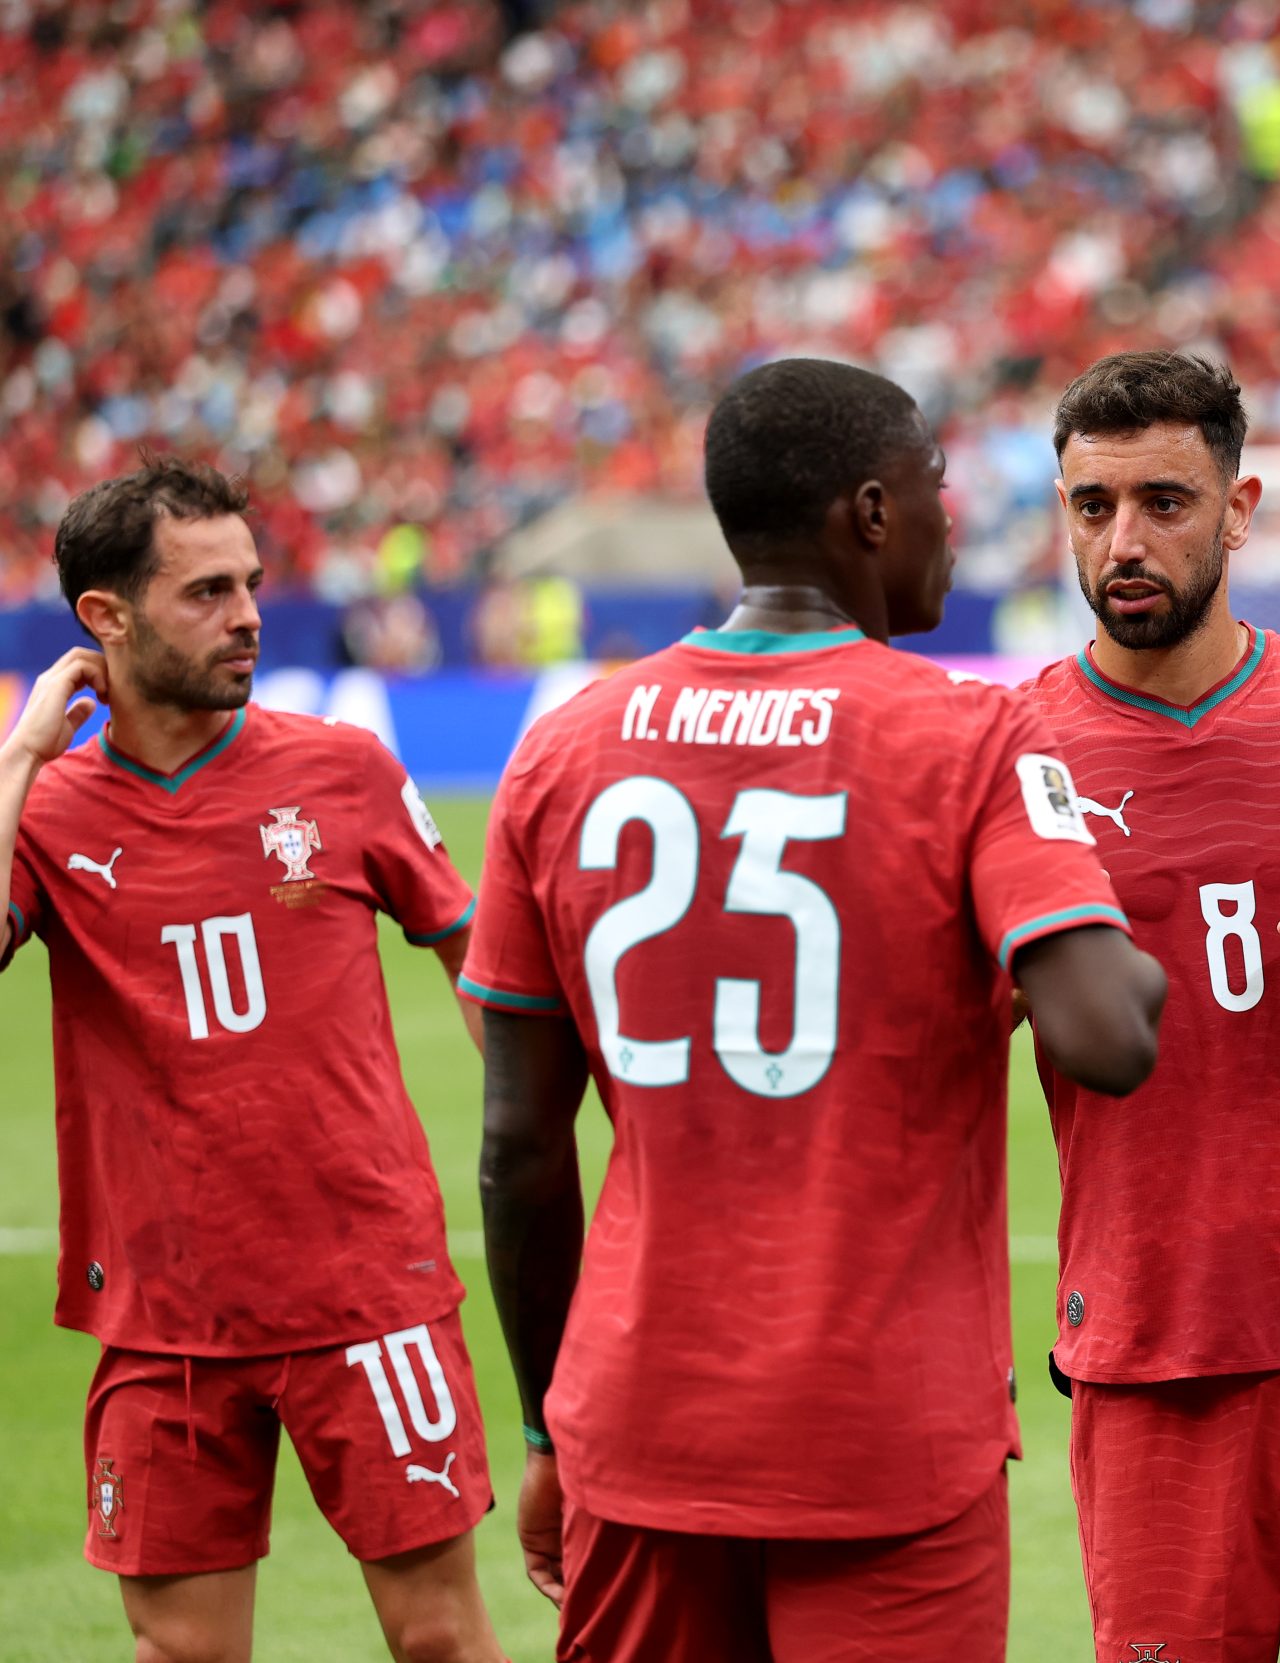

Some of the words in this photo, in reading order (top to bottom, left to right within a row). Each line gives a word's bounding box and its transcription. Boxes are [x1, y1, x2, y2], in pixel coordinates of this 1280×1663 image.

[621, 684, 662, 742] N.
[665, 686, 842, 747] MENDES
[160, 911, 267, 1041] 10
[577, 774, 849, 1099] 25
[1198, 879, 1265, 1013] 8
[345, 1322, 457, 1459] 10
